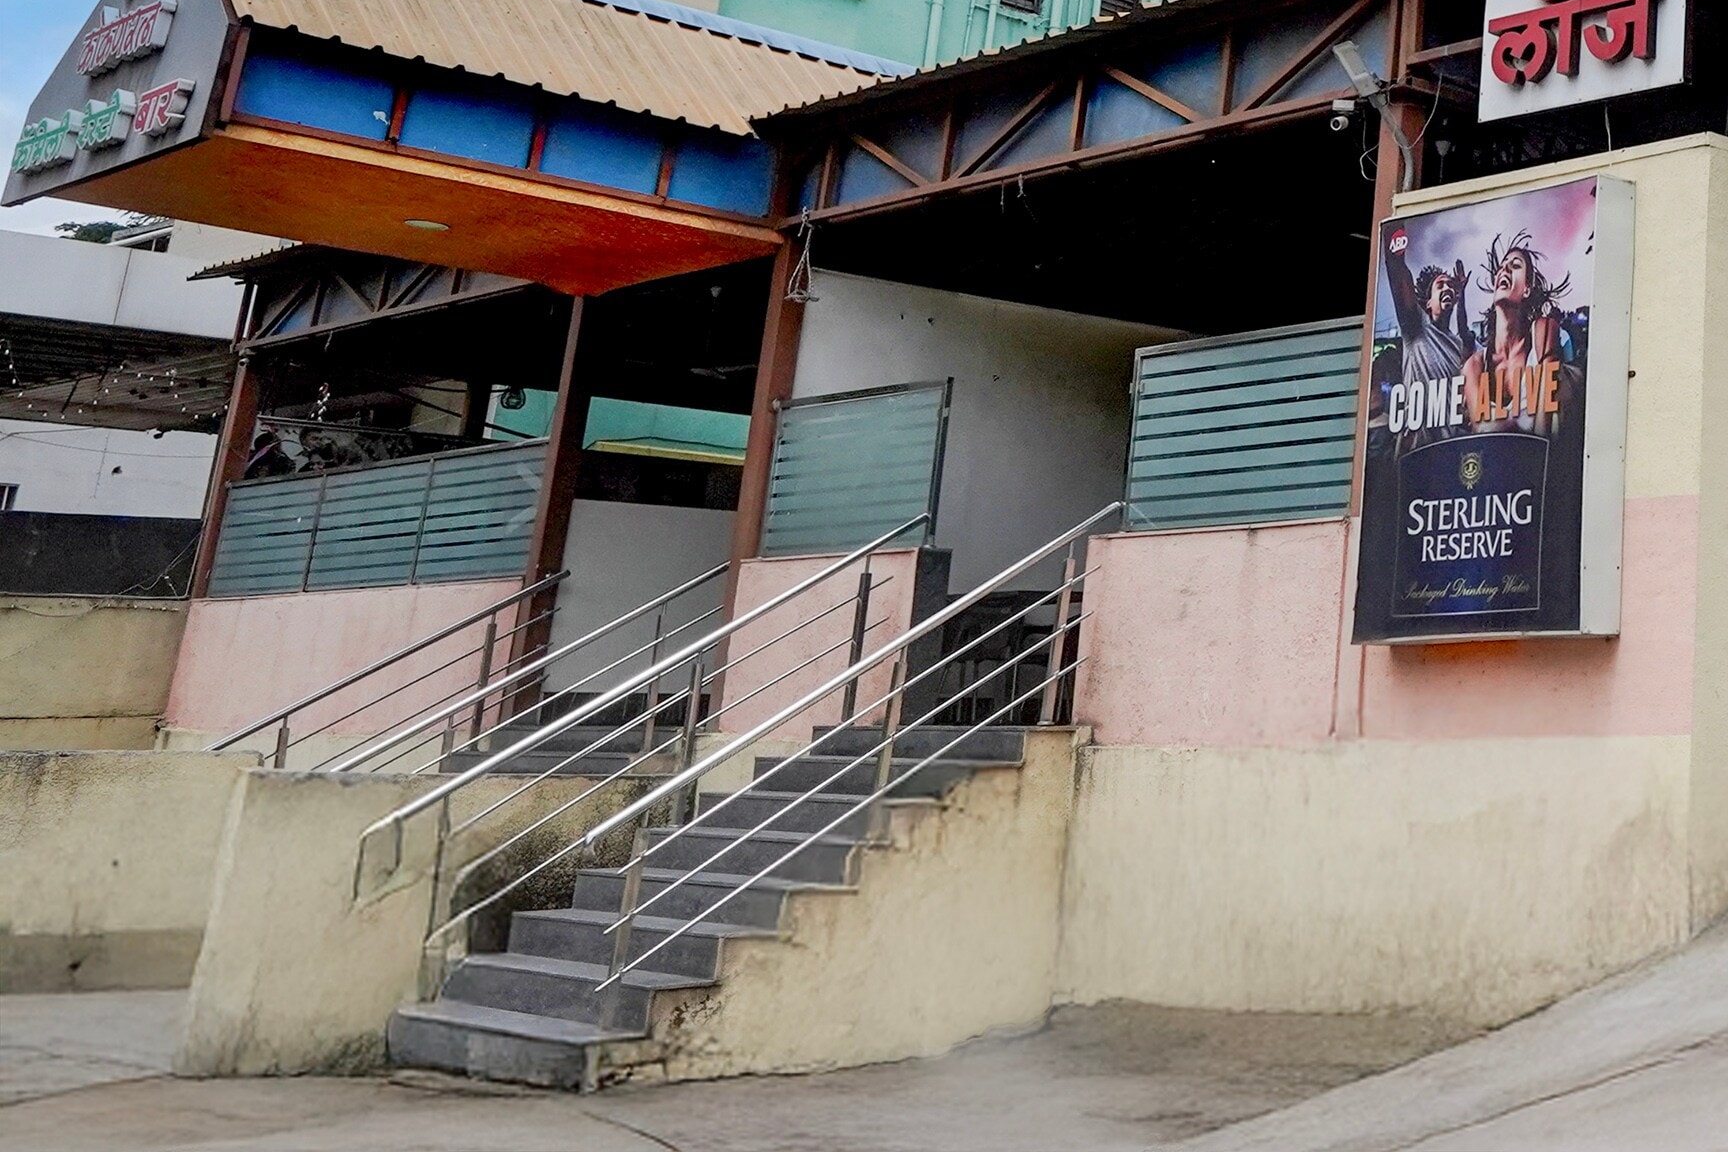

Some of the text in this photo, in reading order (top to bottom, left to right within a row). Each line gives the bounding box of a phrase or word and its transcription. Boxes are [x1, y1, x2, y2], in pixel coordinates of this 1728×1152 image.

[134, 78, 188, 135] बार
[1389, 236, 1408, 253] ABD
[1388, 361, 1560, 433] COME ALIVE
[1407, 489, 1532, 535] STERLING
[1421, 529, 1513, 562] RESERVE
[1450, 578, 1499, 602] Drinking
[1502, 574, 1531, 595] Water
